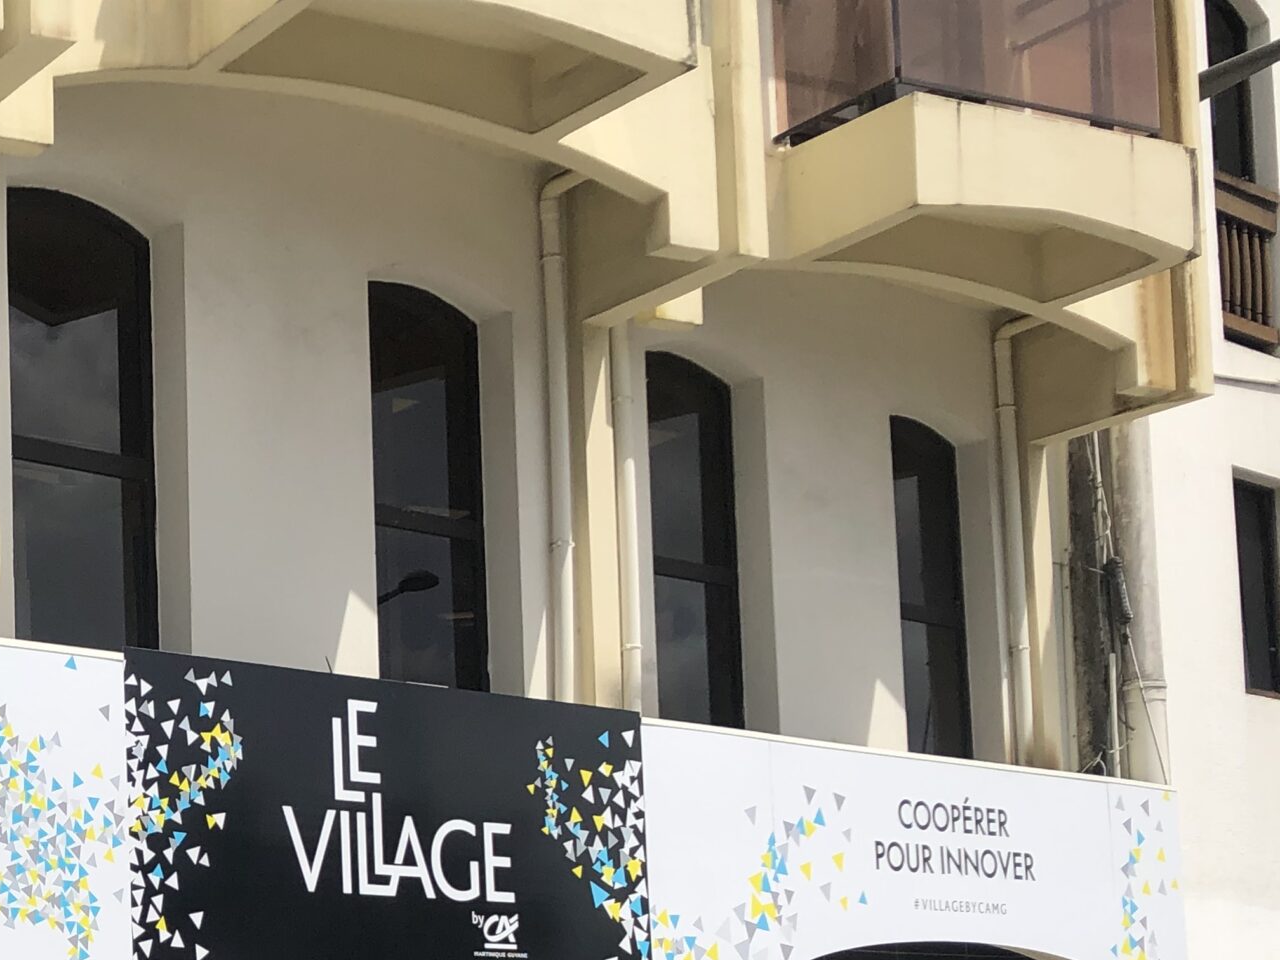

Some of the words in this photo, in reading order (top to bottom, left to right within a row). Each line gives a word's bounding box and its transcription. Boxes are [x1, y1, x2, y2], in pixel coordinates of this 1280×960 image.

[331, 698, 381, 803] LE
[898, 796, 1010, 838] COOPÉRER
[281, 792, 516, 903] VILLAGE
[875, 840, 935, 874] POUR
[940, 846, 1036, 882] INNOVER
[471, 910, 485, 929] by
[914, 898, 1008, 915] #VILLAGEBYCAMG
